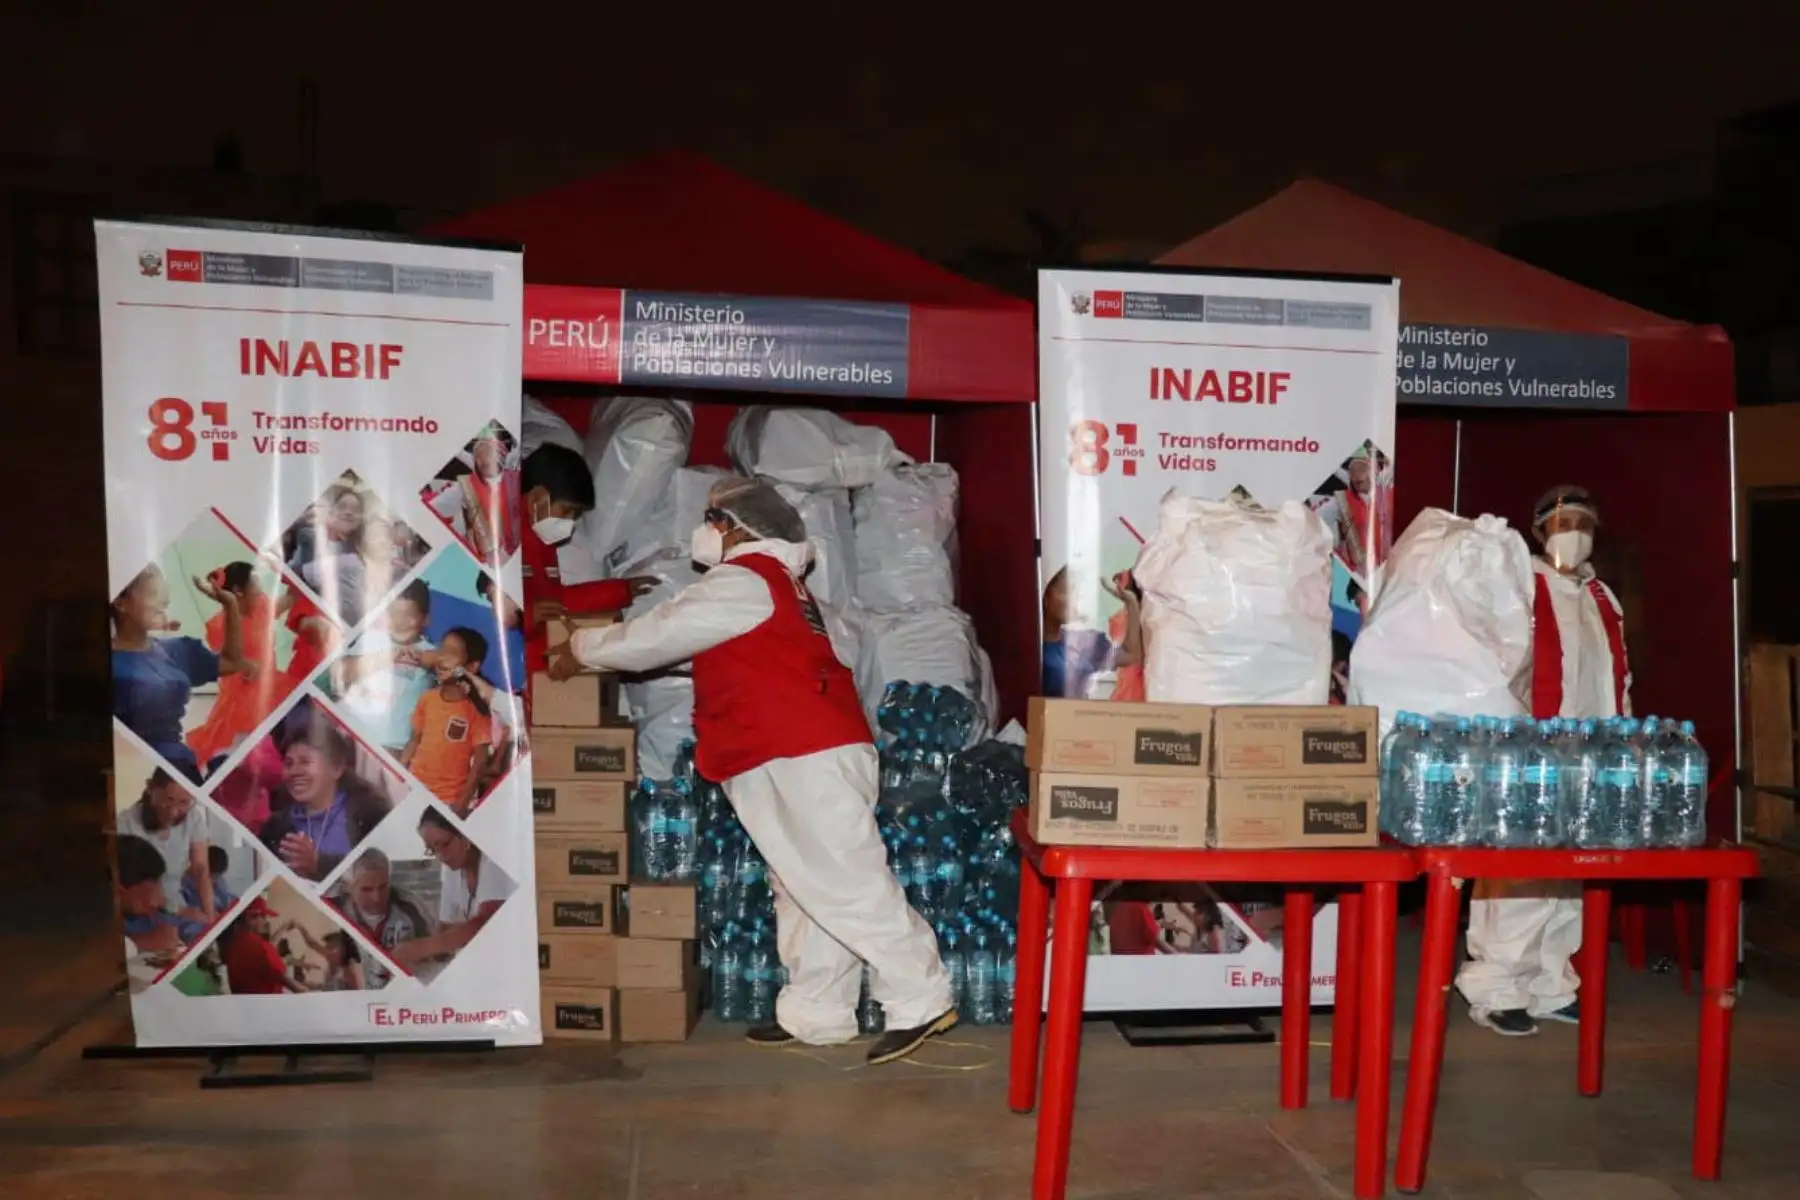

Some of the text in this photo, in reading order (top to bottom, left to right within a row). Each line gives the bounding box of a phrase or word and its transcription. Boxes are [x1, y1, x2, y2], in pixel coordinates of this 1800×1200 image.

[636, 302, 745, 325] Ministerio
[529, 315, 609, 349] PERÚ
[634, 328, 776, 356] de la Mujer y
[1398, 326, 1489, 346] Ministerio
[239, 337, 404, 380] INABIF
[634, 353, 893, 385] Poblaciones Vulnerables
[1420, 351, 1437, 369] la
[1443, 352, 1500, 375] Mujer
[1504, 358, 1516, 375] y
[1149, 367, 1291, 405] INABIF
[1508, 378, 1616, 399] Vulnerables
[252, 411, 439, 433] Transformando
[201, 428, 239, 440] años
[1158, 432, 1320, 453] Transformando
[253, 436, 320, 454] Vidas
[1113, 446, 1145, 458] años
[1158, 454, 1217, 472] Vidas
[1140, 736, 1191, 755] Frugos
[1307, 737, 1357, 754] Frugos
[1060, 797, 1114, 815] Frugos
[1308, 807, 1357, 825] Frugos
